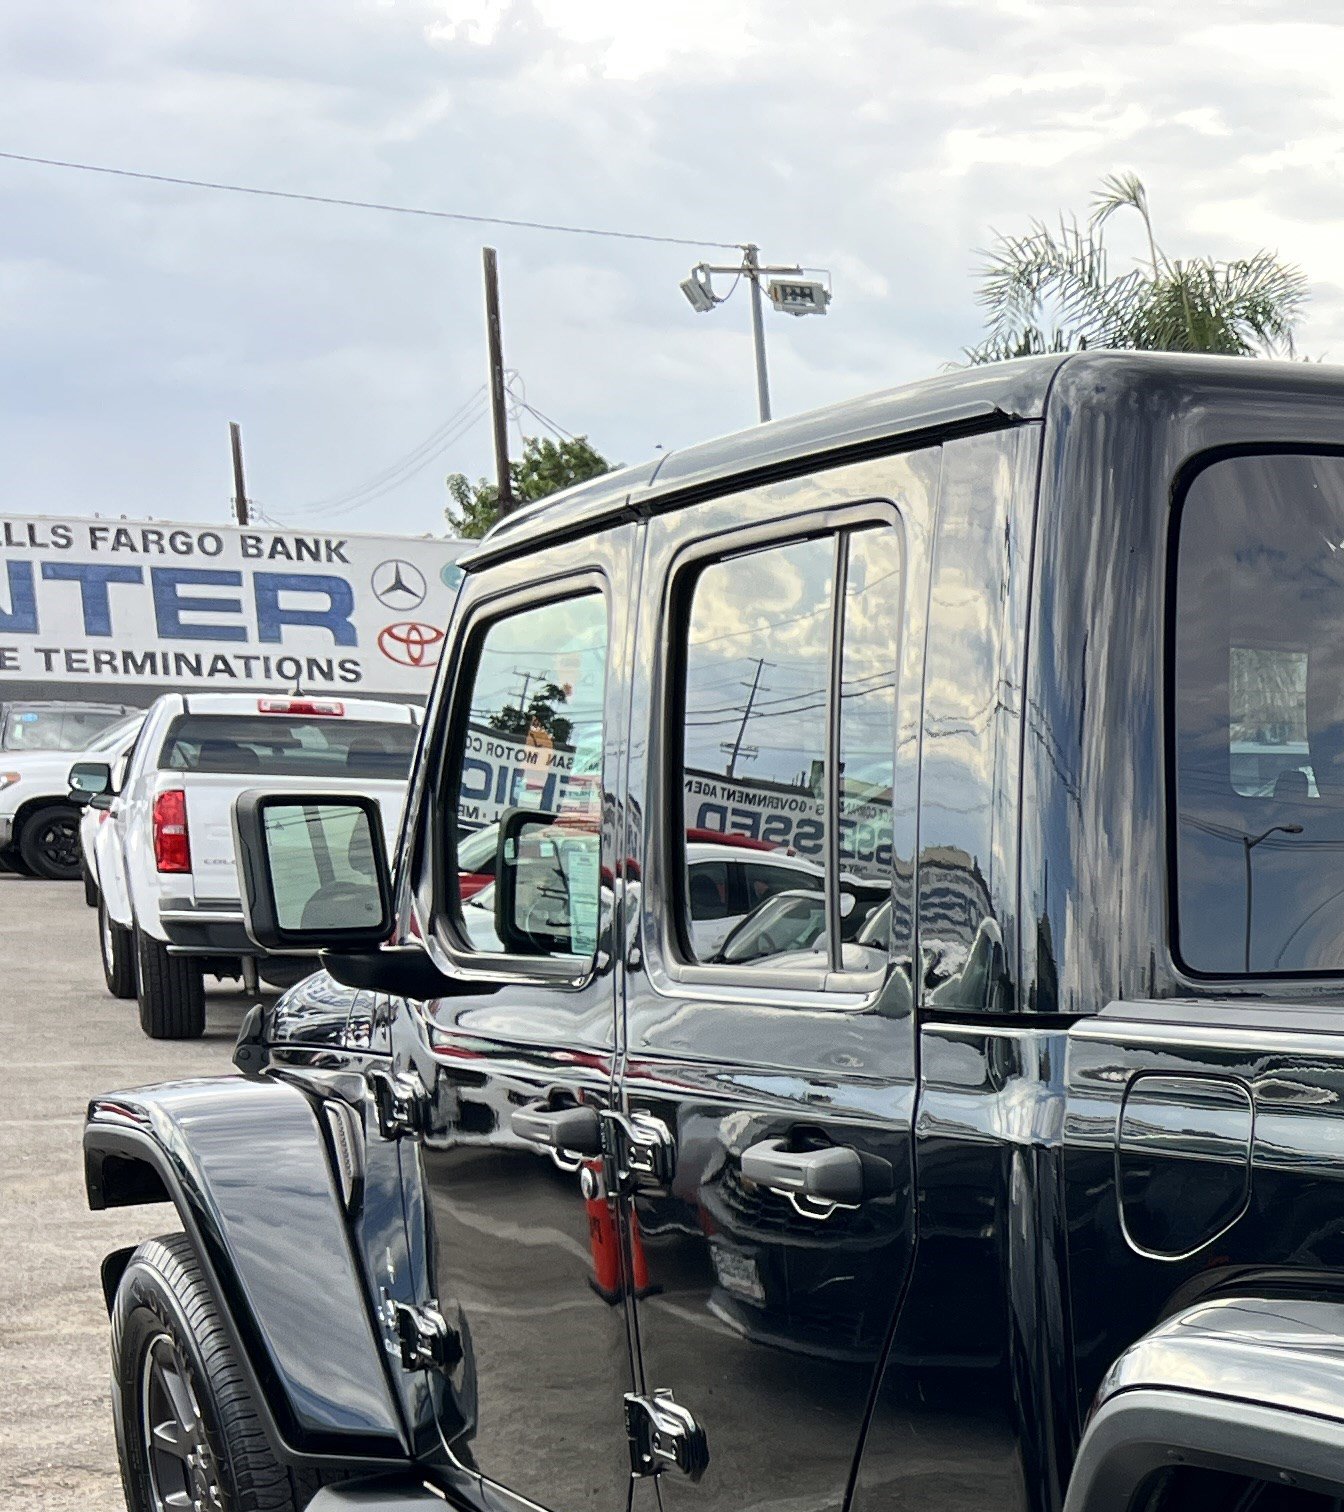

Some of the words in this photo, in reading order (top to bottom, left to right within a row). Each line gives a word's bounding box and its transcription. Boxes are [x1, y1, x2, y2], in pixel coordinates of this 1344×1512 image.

[0, 521, 73, 549] LLS
[89, 527, 224, 557] FARGO
[240, 534, 351, 564] BANK
[35, 647, 362, 683] TERMINATIONS
